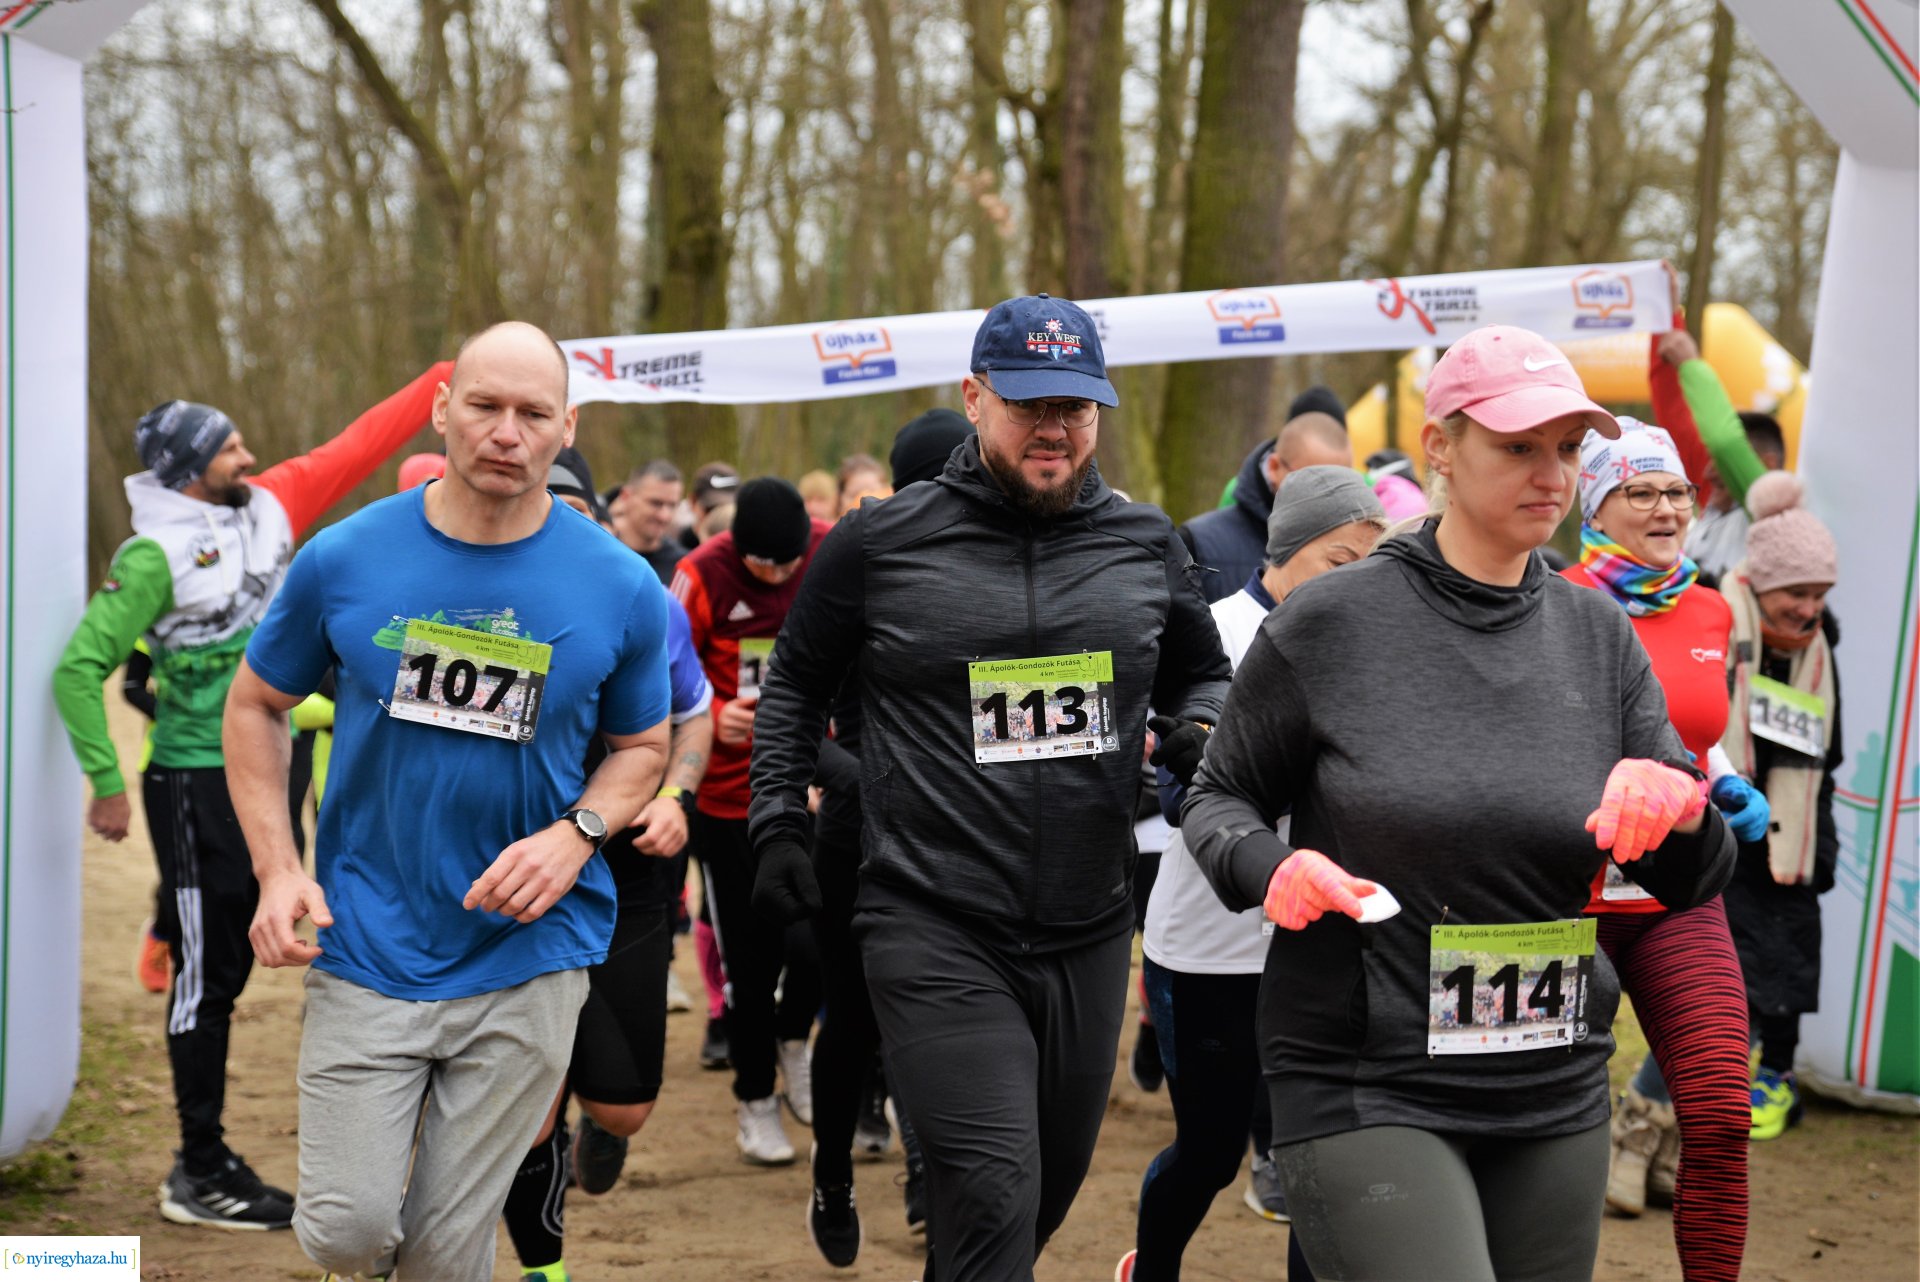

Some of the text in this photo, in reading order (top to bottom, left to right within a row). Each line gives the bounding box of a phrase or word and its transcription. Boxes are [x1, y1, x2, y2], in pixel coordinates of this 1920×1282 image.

[1028, 332, 1081, 345] KEY WEST
[491, 619, 519, 630] great
[416, 623, 426, 632] III.
[494, 637, 519, 649] Futása
[990, 660, 1055, 673] Ápolók-Gondozók
[1056, 659, 1081, 667] Futása
[409, 652, 518, 713] 107
[979, 685, 1089, 740] 113
[1458, 928, 1535, 940] Ápolók-Gondozók
[1537, 926, 1564, 935] Futása
[1441, 960, 1566, 1025] 114
